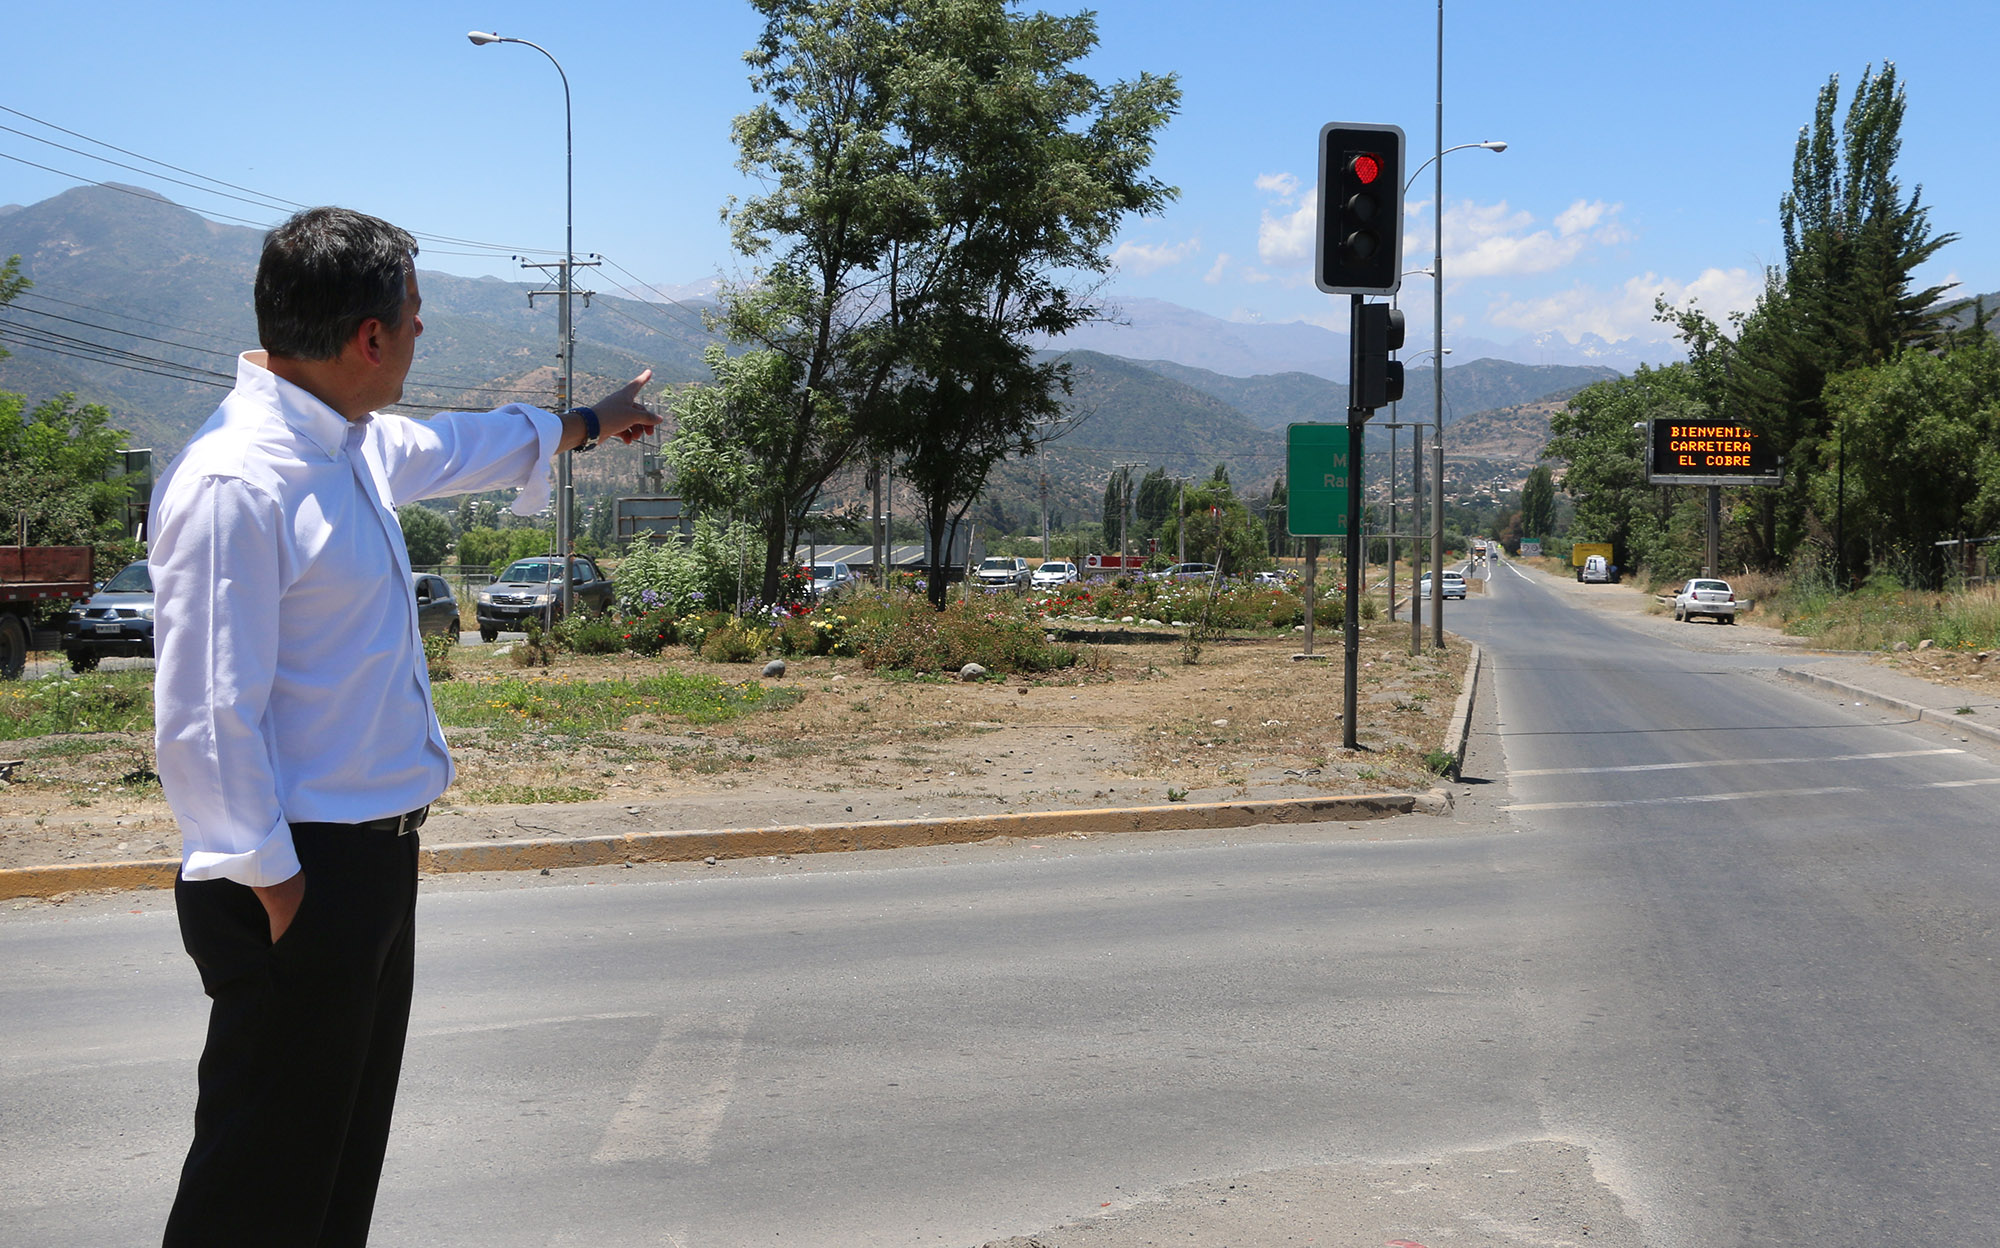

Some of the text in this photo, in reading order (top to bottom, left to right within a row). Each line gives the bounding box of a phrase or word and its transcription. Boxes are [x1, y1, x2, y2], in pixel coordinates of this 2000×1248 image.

[1671, 426, 1759, 438] BIENVENID
[1671, 441, 1752, 452] CARRETERA
[1679, 455, 1751, 466] EL COBRE
